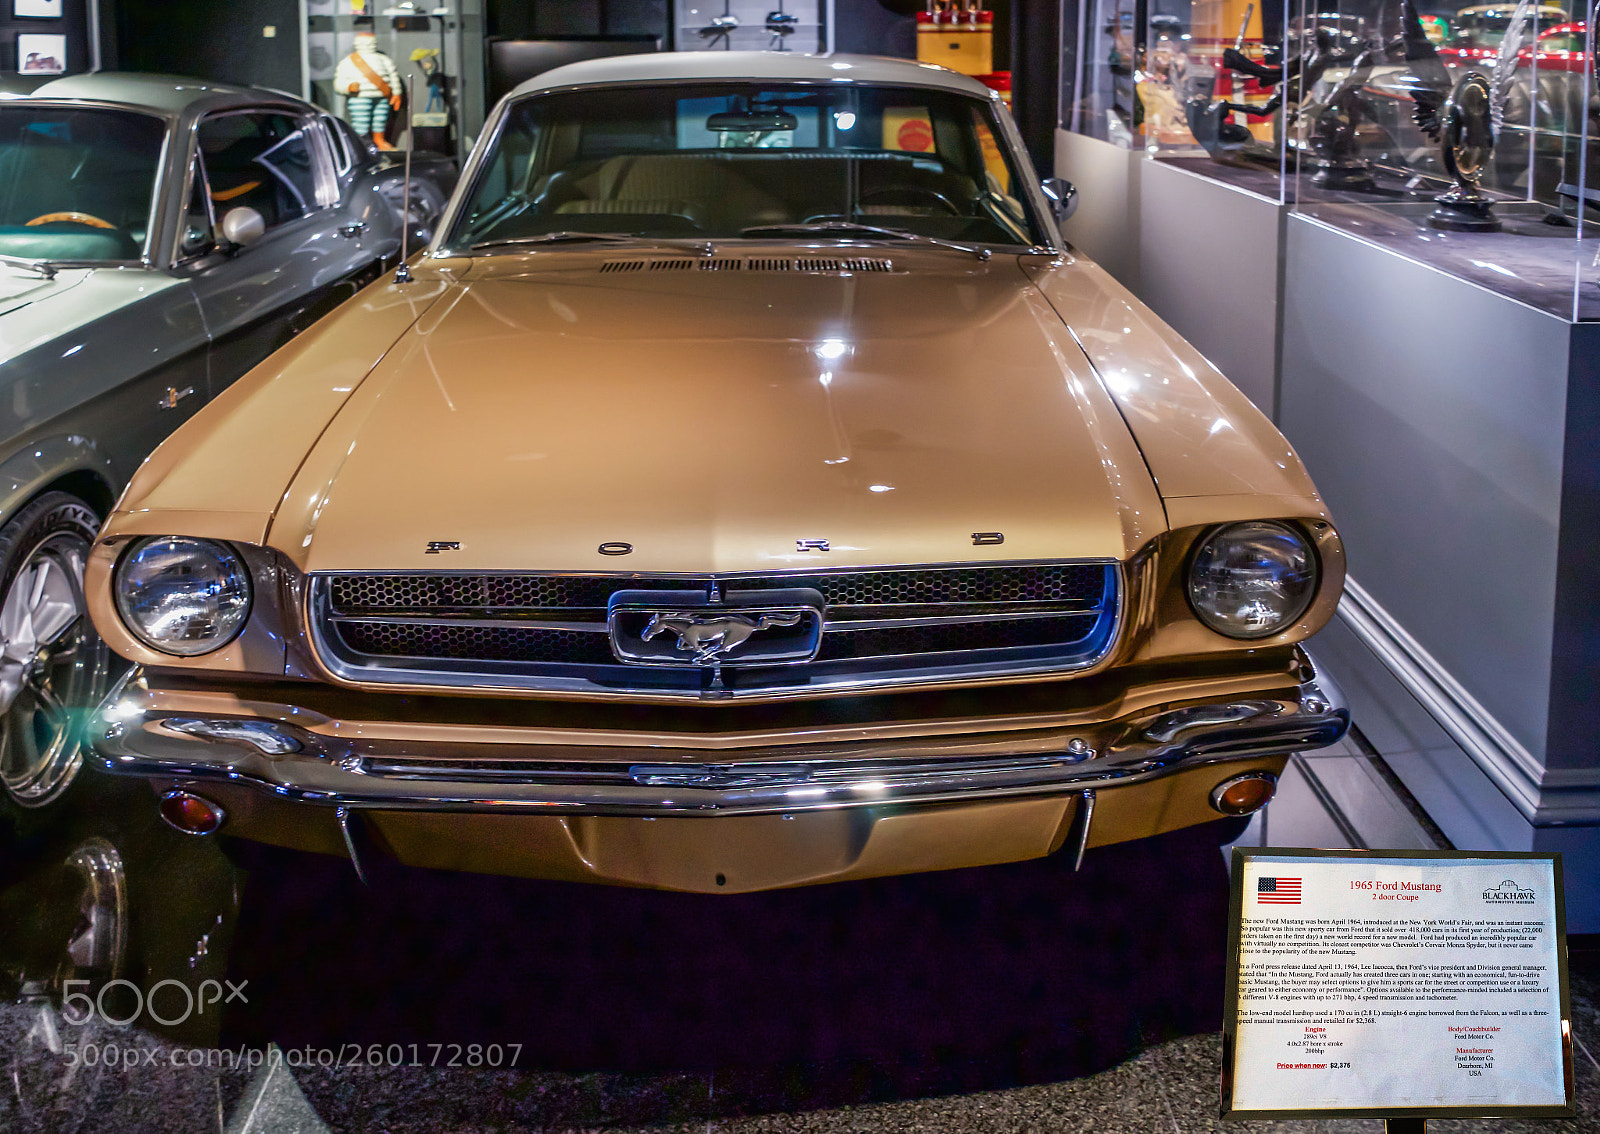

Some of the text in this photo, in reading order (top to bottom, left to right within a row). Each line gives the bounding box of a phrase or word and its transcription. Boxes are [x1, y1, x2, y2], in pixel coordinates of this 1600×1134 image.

[1350, 881, 1442, 892] 1965 Ford Mustang
[1396, 894, 1419, 902] Coupe
[1280, 918, 1304, 926] Mustang
[1331, 918, 1346, 926] April
[1249, 925, 1271, 933] popular
[1308, 926, 1325, 934] sporty
[1490, 926, 1521, 934] production;
[1305, 933, 1319, 941] day)
[1445, 934, 1471, 942] produced
[1479, 934, 1506, 942] incredibly
[1507, 934, 1527, 942] popular
[1254, 940, 1278, 948] virtually
[1286, 940, 1322, 949] competition.
[1350, 941, 1380, 949] competitor
[1466, 941, 1487, 949] Spyder,
[1272, 948, 1300, 956] popularity
[1332, 948, 1357, 956] Mustang.
[1318, 963, 1334, 971] April
[1440, 964, 1465, 972] president
[1502, 964, 1522, 972] general
[1289, 970, 1314, 978] Mustang,
[1330, 970, 1352, 979] actually
[1432, 971, 1452, 979] starting
[1254, 978, 1280, 986] Mustang,
[1291, 978, 1308, 986] buyer
[1338, 978, 1360, 986] options
[1367, 978, 1379, 986] give
[1397, 978, 1414, 986] sports
[1466, 979, 1499, 987] competition
[1248, 986, 1267, 994] geared
[1366, 986, 1388, 994] Options
[1432, 986, 1488, 994] performance-minded
[1280, 994, 1302, 1002] engines
[1362, 994, 1379, 1002] speed
[1382, 1009, 1408, 1017] straight-6
[1408, 1009, 1428, 1017] engine
